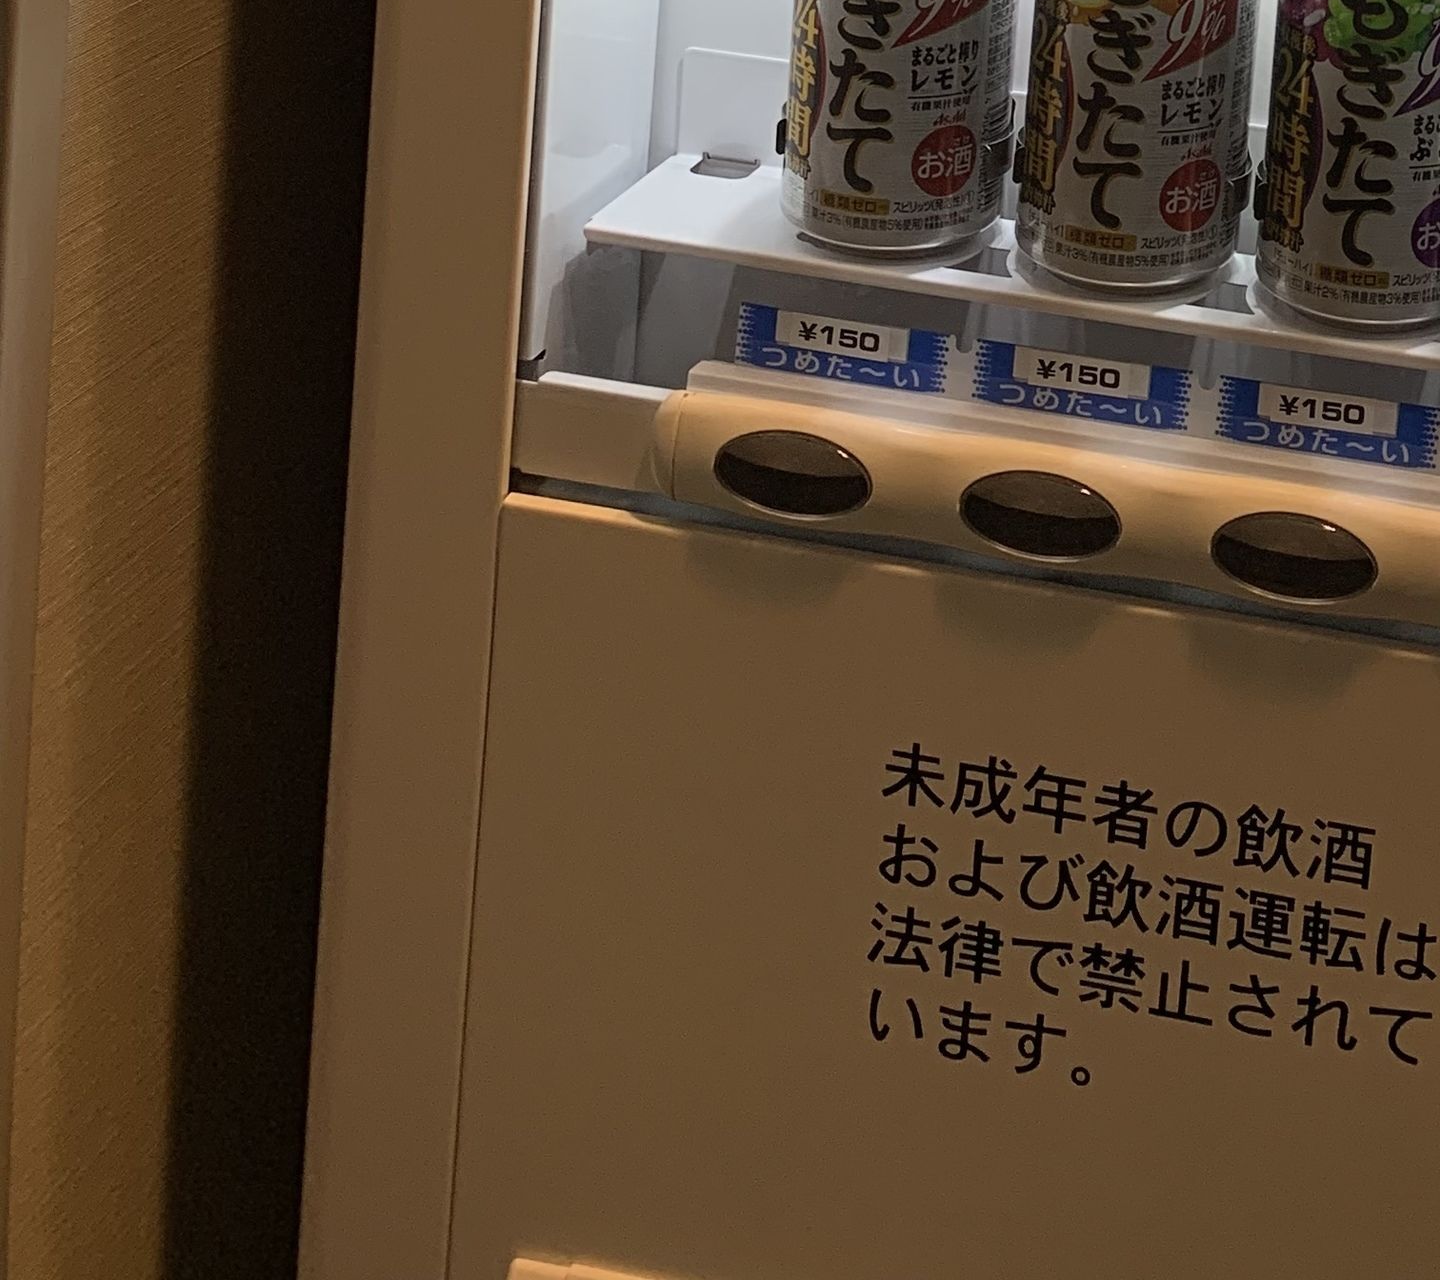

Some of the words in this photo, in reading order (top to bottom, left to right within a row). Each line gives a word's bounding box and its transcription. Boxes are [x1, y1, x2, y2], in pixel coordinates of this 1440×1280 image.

[917, 147, 973, 181] お酒
[1165, 178, 1218, 214] お酒
[797, 320, 881, 354] ¥150
[1035, 357, 1122, 390] ¥150
[1278, 393, 1366, 427] ¥150
[881, 742, 1377, 890] 未成年者の飲酒
[877, 823, 1438, 981] および飲酒運転は
[866, 902, 1434, 1066] 法律で禁止されて
[867, 987, 1091, 1086] います。
